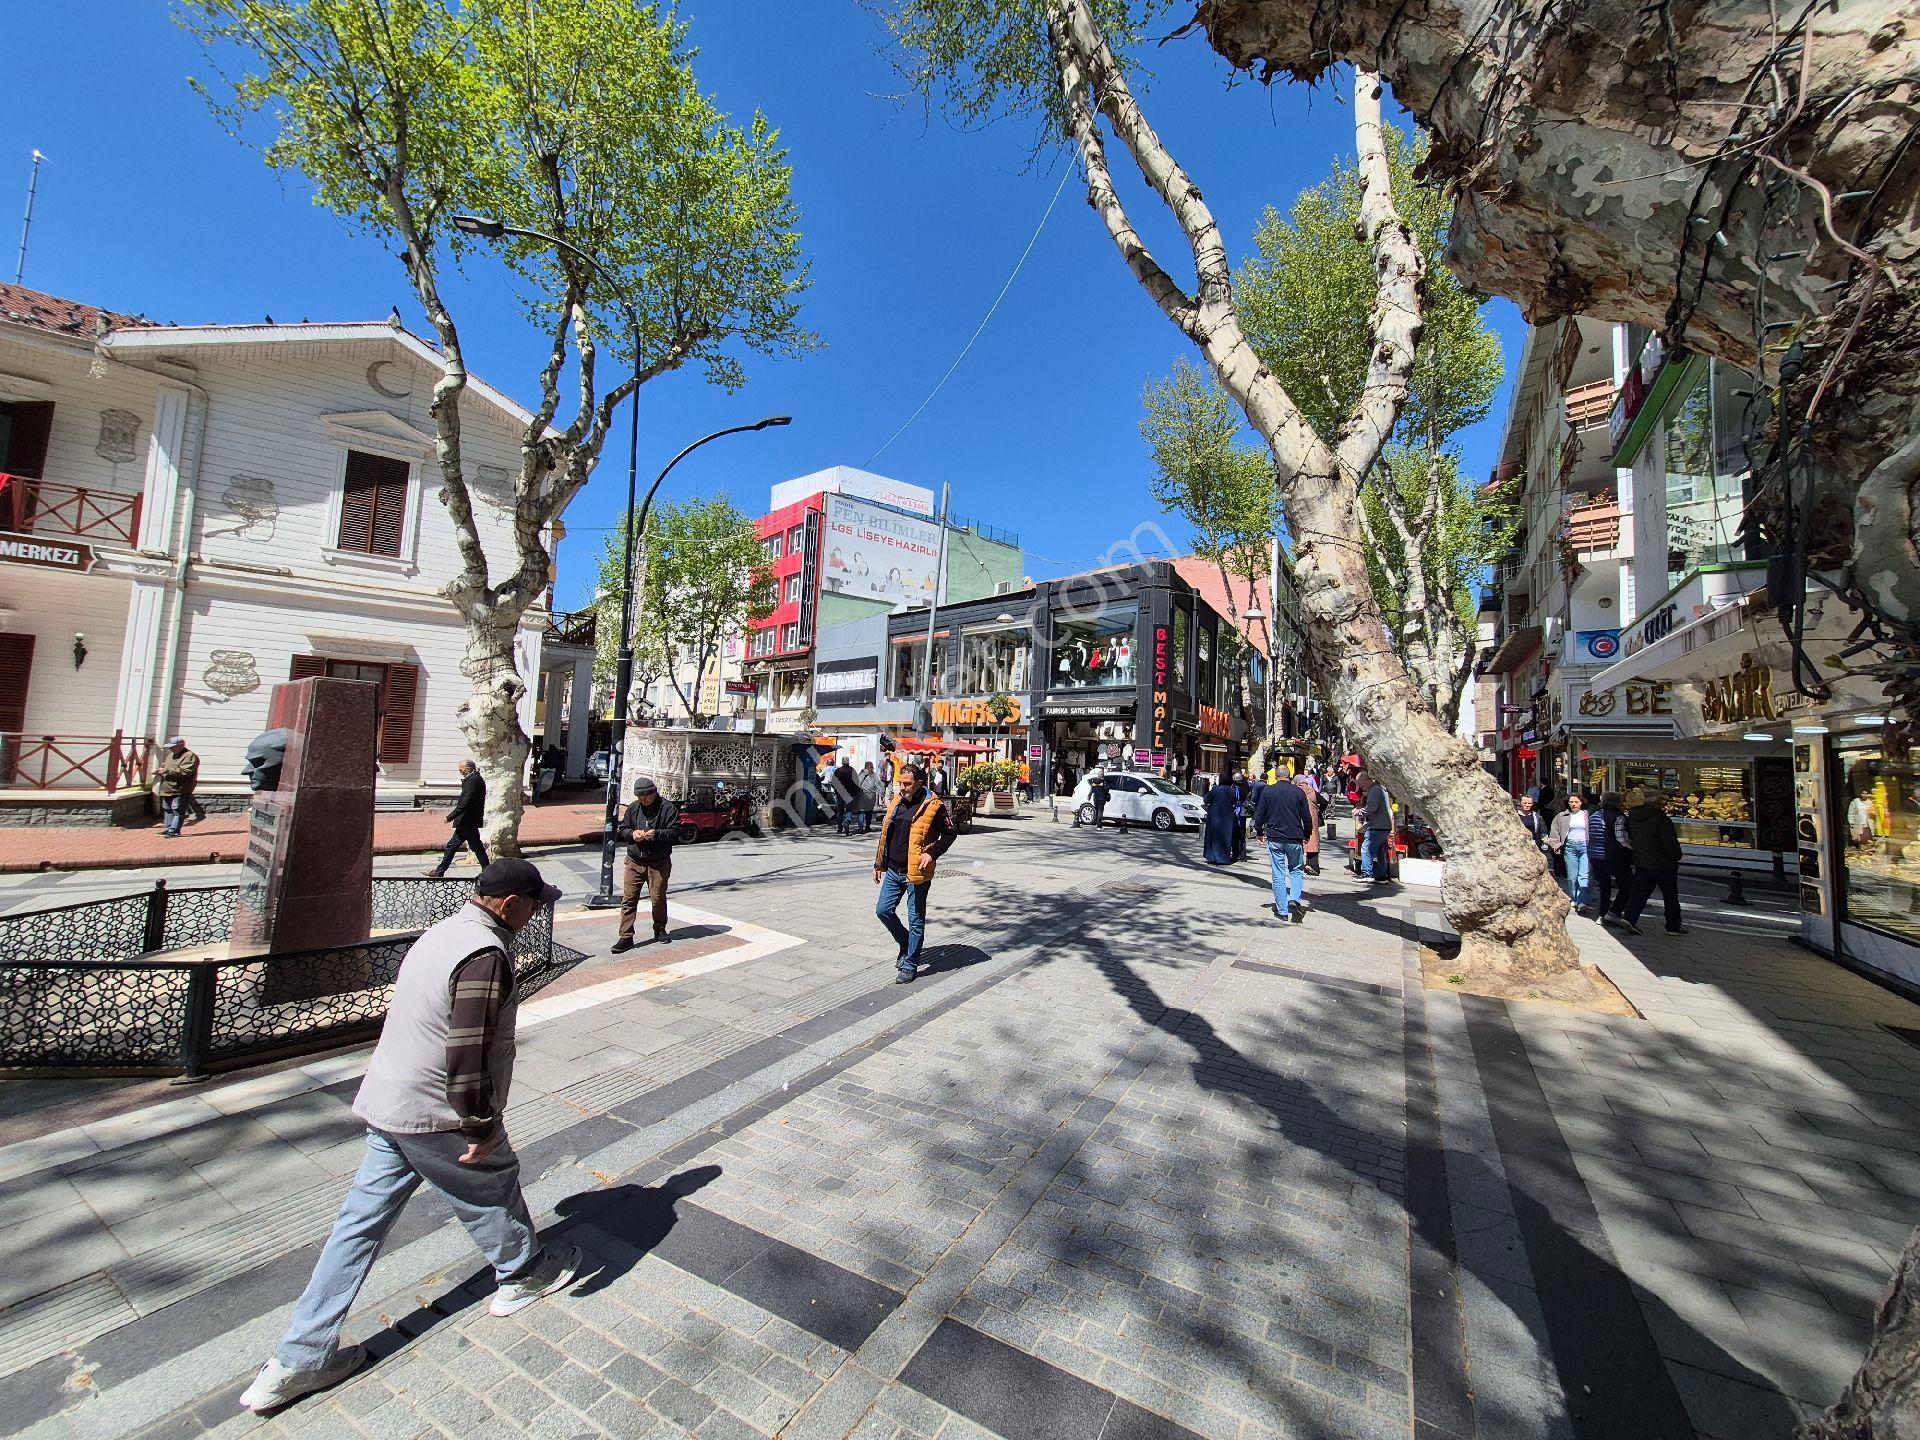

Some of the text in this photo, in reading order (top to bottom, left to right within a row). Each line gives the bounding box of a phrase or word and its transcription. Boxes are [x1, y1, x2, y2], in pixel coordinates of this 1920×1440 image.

[832, 505, 865, 525] FEN
[831, 521, 854, 535] LGS
[857, 527, 894, 546] LİSEYE
[0, 540, 80, 565] MERKEZİ
[1156, 628, 1168, 685] BEST
[1153, 690, 1168, 748] MALL
